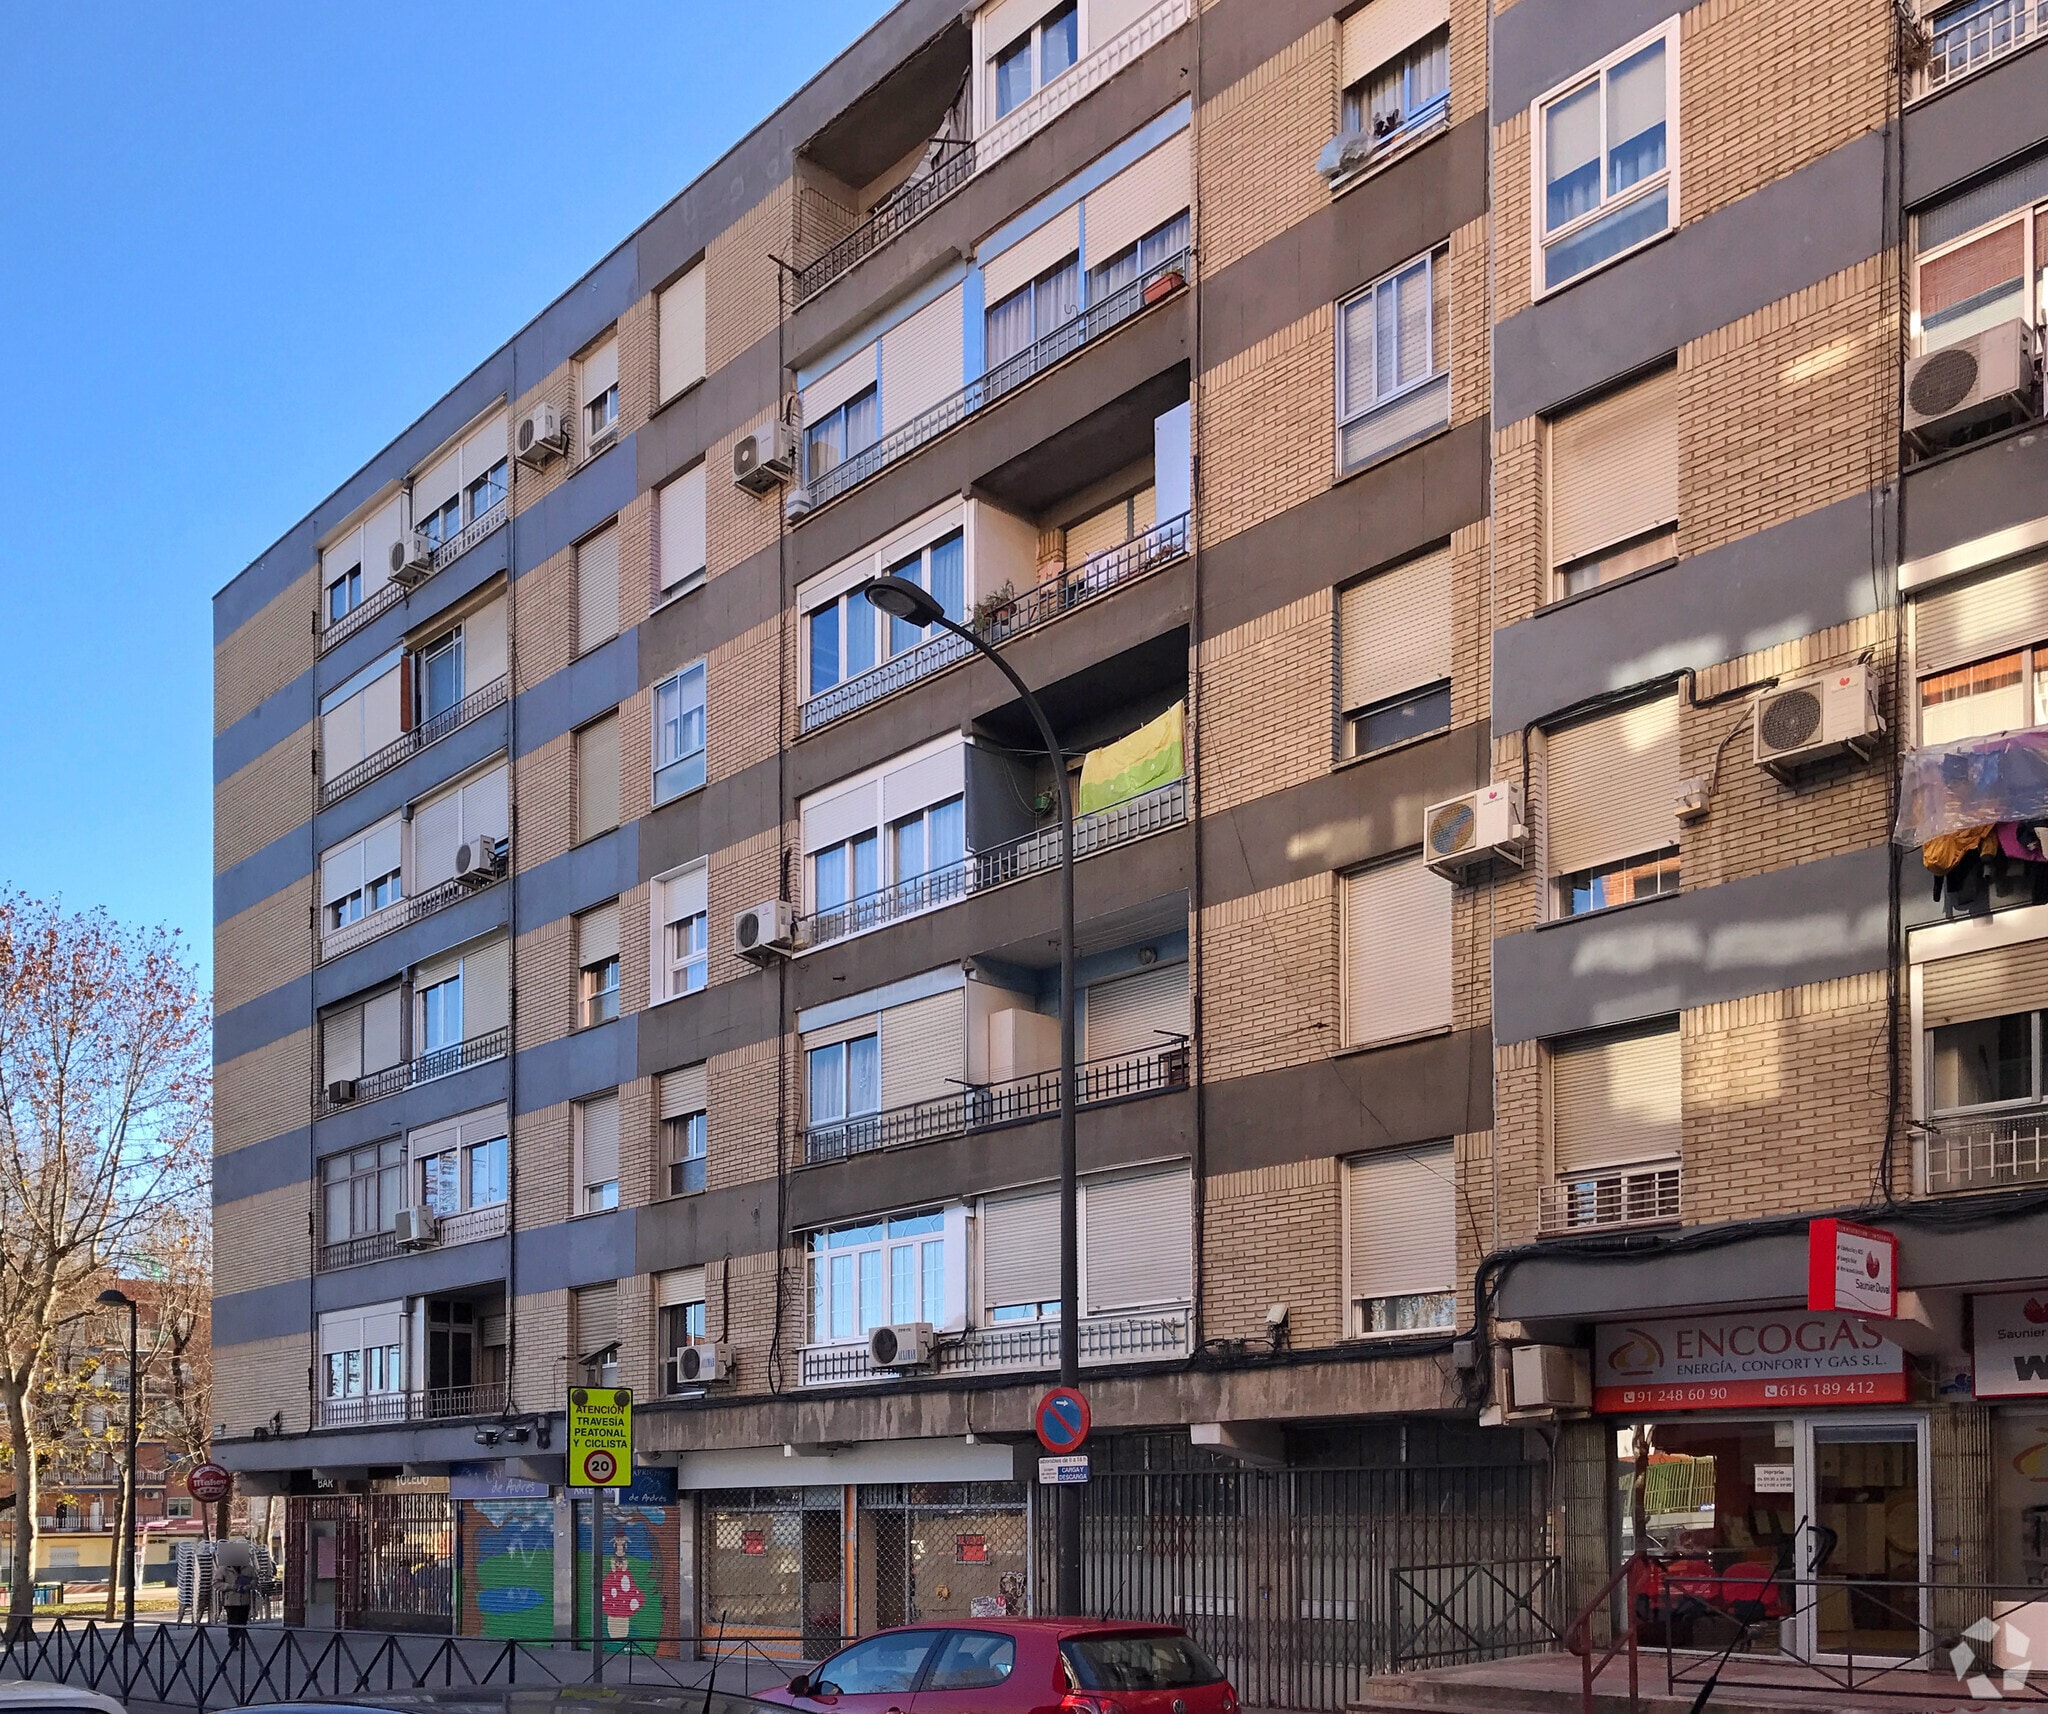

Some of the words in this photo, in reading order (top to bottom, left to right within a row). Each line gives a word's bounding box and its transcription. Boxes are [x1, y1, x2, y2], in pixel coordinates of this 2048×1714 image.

[1855, 1278, 1875, 1292] Saunier
[1876, 1282, 1891, 1295] Duval
[1676, 1319, 1883, 1360] ENCOGAS
[1997, 1329, 2046, 1340] Saunier
[1677, 1360, 1737, 1376] ENERGÍA,
[1742, 1357, 1811, 1372] CONFORT
[1814, 1357, 1824, 1368] Y
[1828, 1355, 1858, 1368] GAS
[1862, 1354, 1887, 1366] S.L.
[1637, 1391, 1652, 1403] 91
[1658, 1389, 1683, 1402] 248
[1688, 1388, 1705, 1400] 60
[1709, 1387, 1727, 1399] 90
[1779, 1384, 1807, 1397] 616
[1813, 1382, 1841, 1395] 189
[1846, 1381, 1875, 1394] 412
[575, 1403, 625, 1415] ATENCIÓN
[576, 1416, 625, 1427] TRAVESÍA
[574, 1428, 626, 1438] PEATONAL
[573, 1438, 580, 1447] Y
[584, 1439, 628, 1449] CICLISTA
[591, 1460, 610, 1472] 20
[317, 1479, 334, 1489] BAR
[395, 1474, 430, 1487] TOLEDO
[628, 1493, 639, 1502] de
